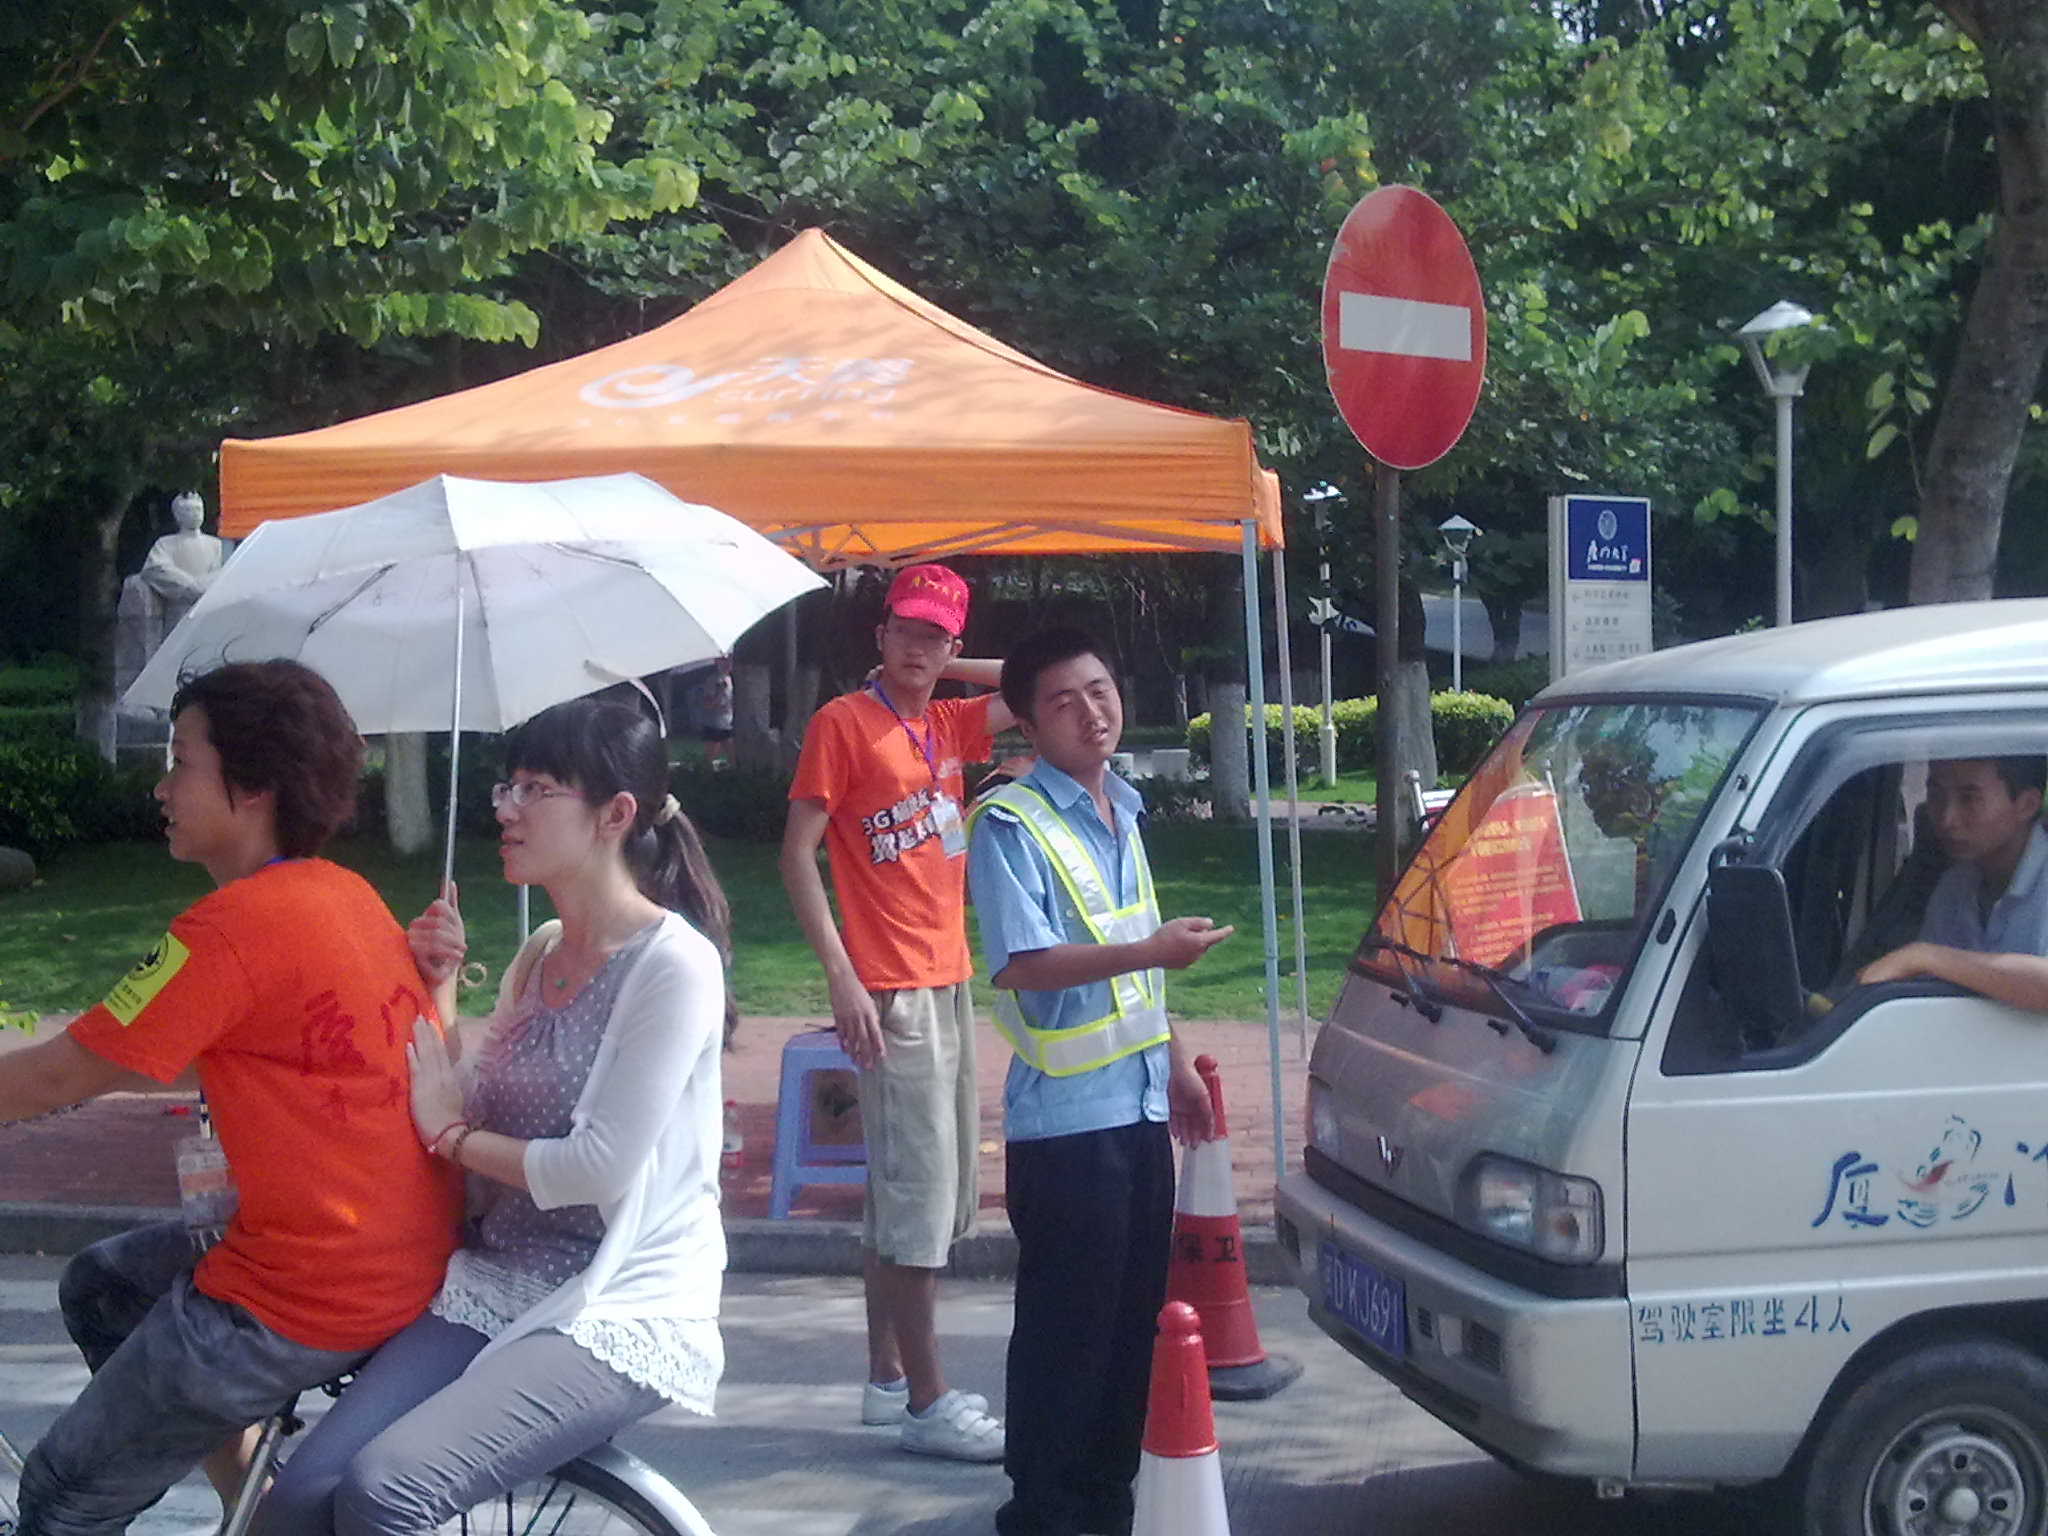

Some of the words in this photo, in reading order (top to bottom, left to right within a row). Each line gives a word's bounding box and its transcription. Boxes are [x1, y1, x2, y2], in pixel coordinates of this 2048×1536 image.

[1638, 1296, 1851, 1343] 驾驶室限坐4人
